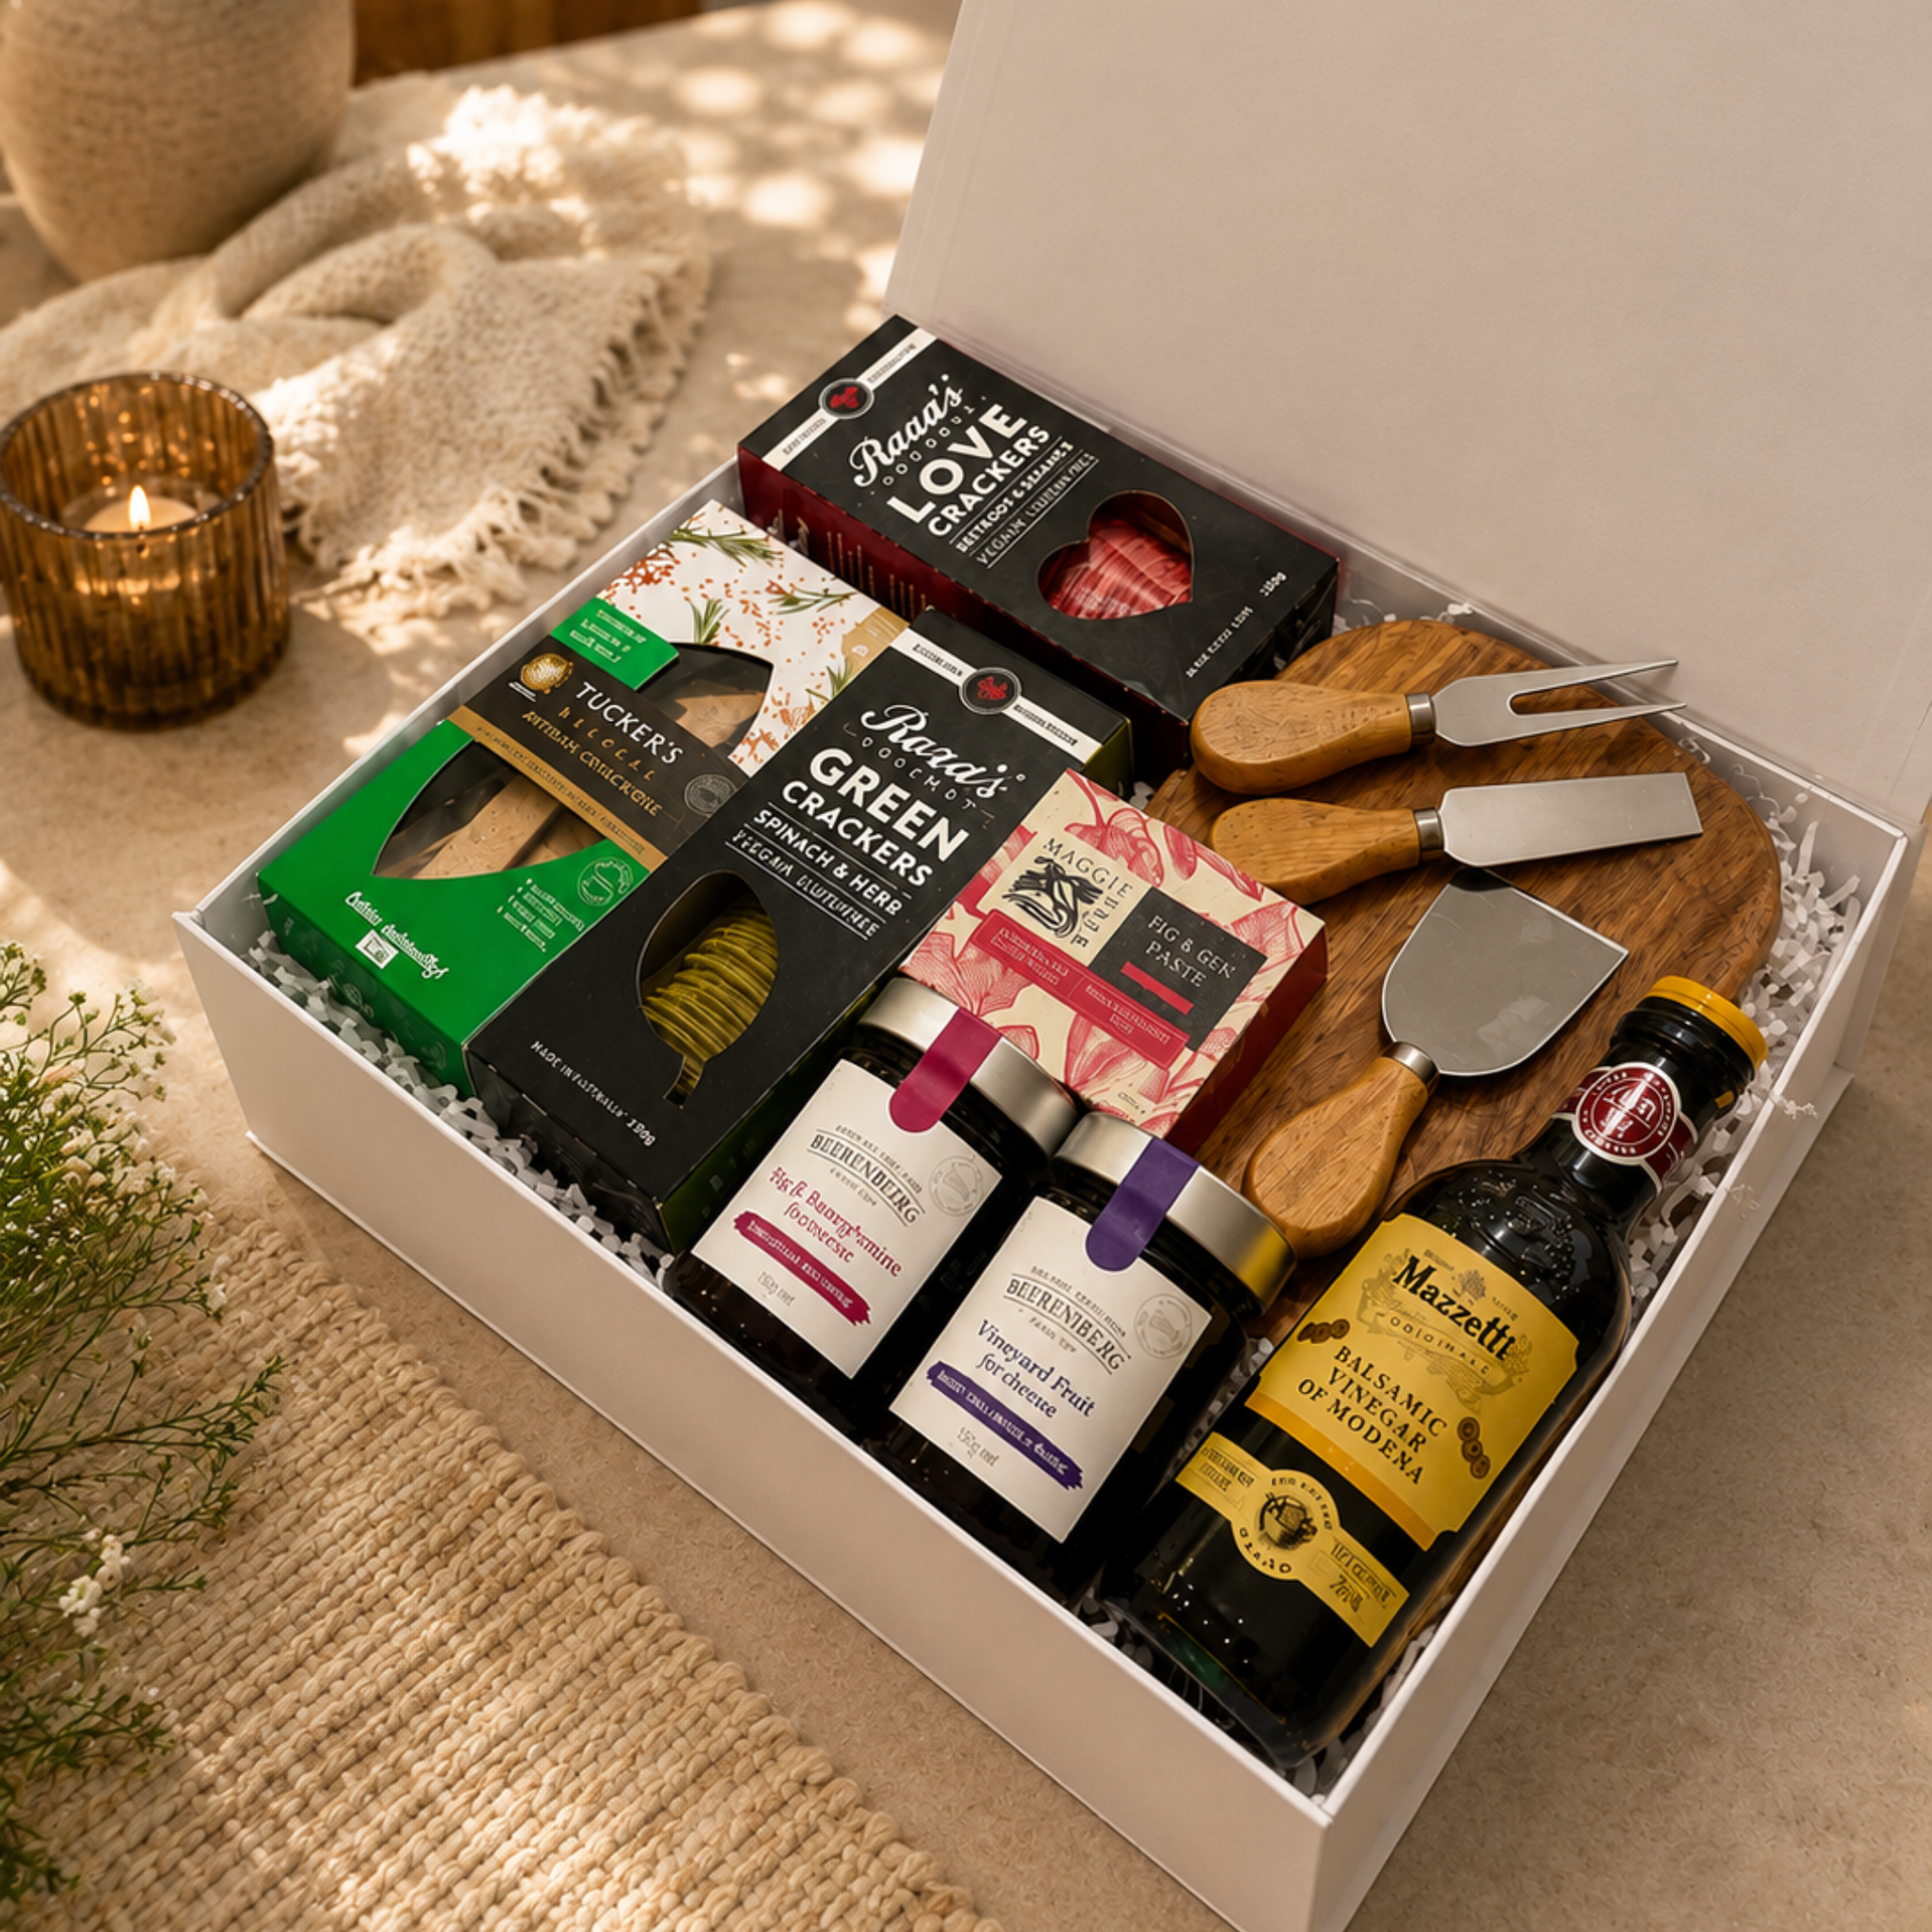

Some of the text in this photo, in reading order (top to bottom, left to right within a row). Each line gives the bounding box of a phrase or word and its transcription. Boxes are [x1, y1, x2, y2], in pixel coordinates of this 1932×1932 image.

[887, 403, 1028, 523] LOVE
[928, 425, 1049, 537] CRACKERS
[575, 681, 684, 764] TUCKER'S
[754, 809, 836, 872] SPINACH
[835, 862, 849, 881] &
[781, 780, 933, 888] CRACKERS
[809, 748, 970, 862] GREEN
[1042, 838, 1134, 899] MAGGIE
[1146, 943, 1208, 990] PASTE
[1148, 914, 1180, 945] FIG
[1391, 1254, 1518, 1363] Mazzetti
[975, 1352, 1005, 1379] for
[1050, 1375, 1097, 1419] Fruit
[1332, 1345, 1449, 1438] BALSAMIC
[1297, 1378, 1425, 1486] OF MODENA
[1327, 1366, 1429, 1453] VINEGAR
